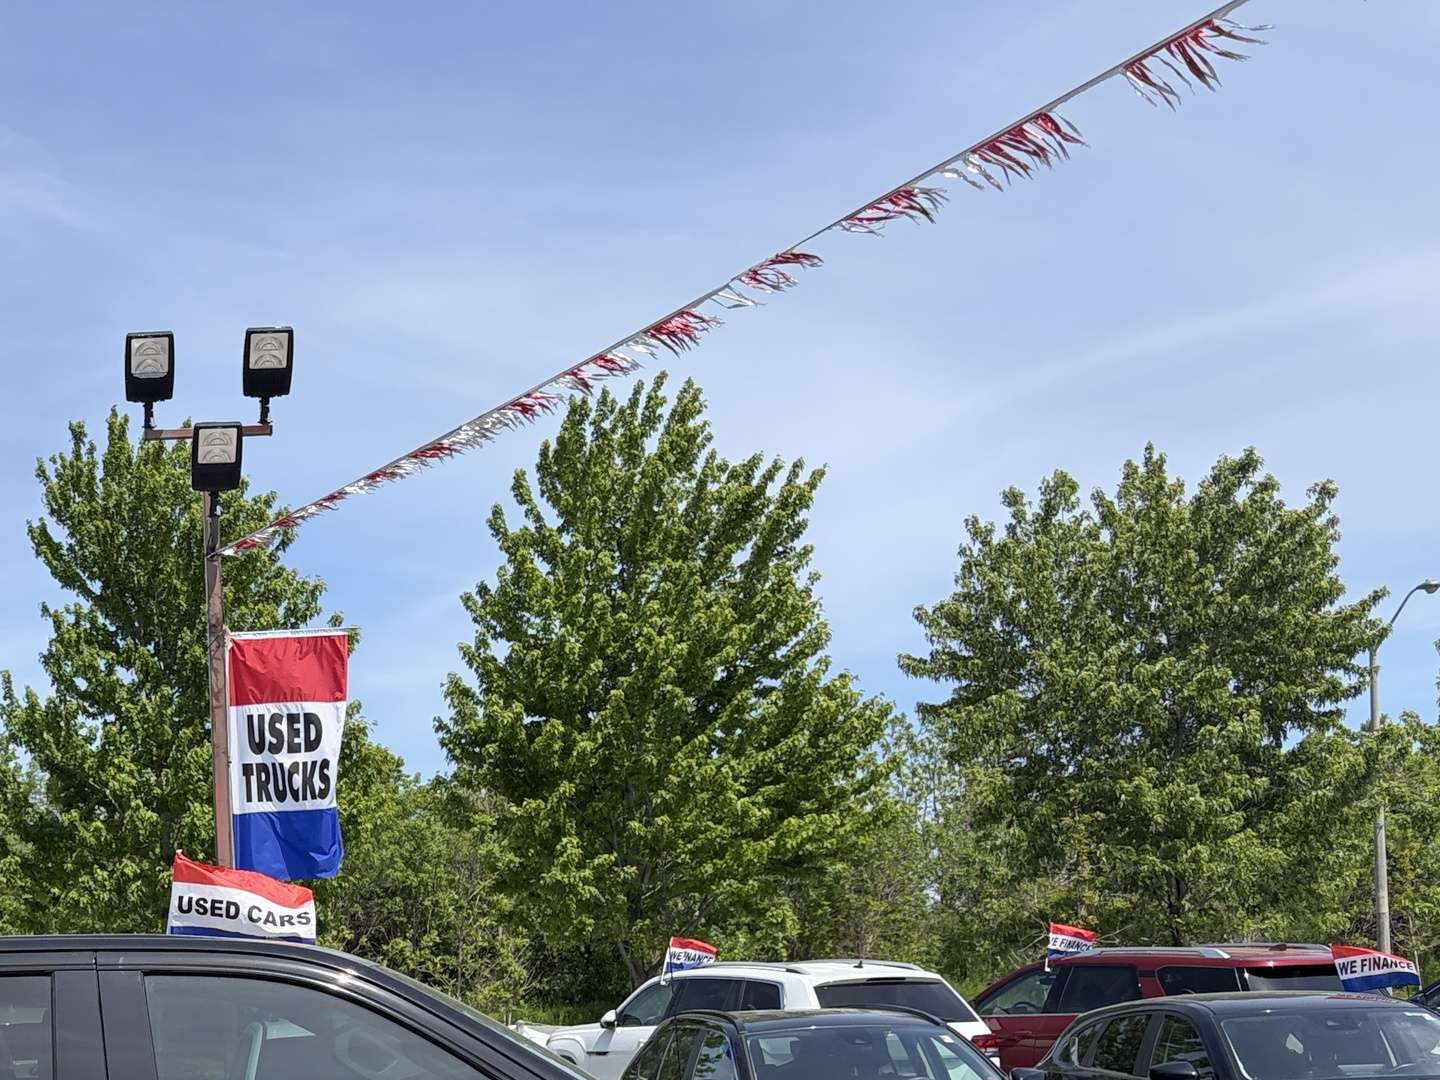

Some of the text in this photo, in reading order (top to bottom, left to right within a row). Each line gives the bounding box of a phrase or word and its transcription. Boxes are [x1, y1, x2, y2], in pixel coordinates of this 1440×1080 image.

[247, 712, 323, 755] USED
[242, 758, 331, 803] TRUCKS
[177, 895, 311, 927] USED CARS
[1338, 957, 1413, 975] WE FINANCE
